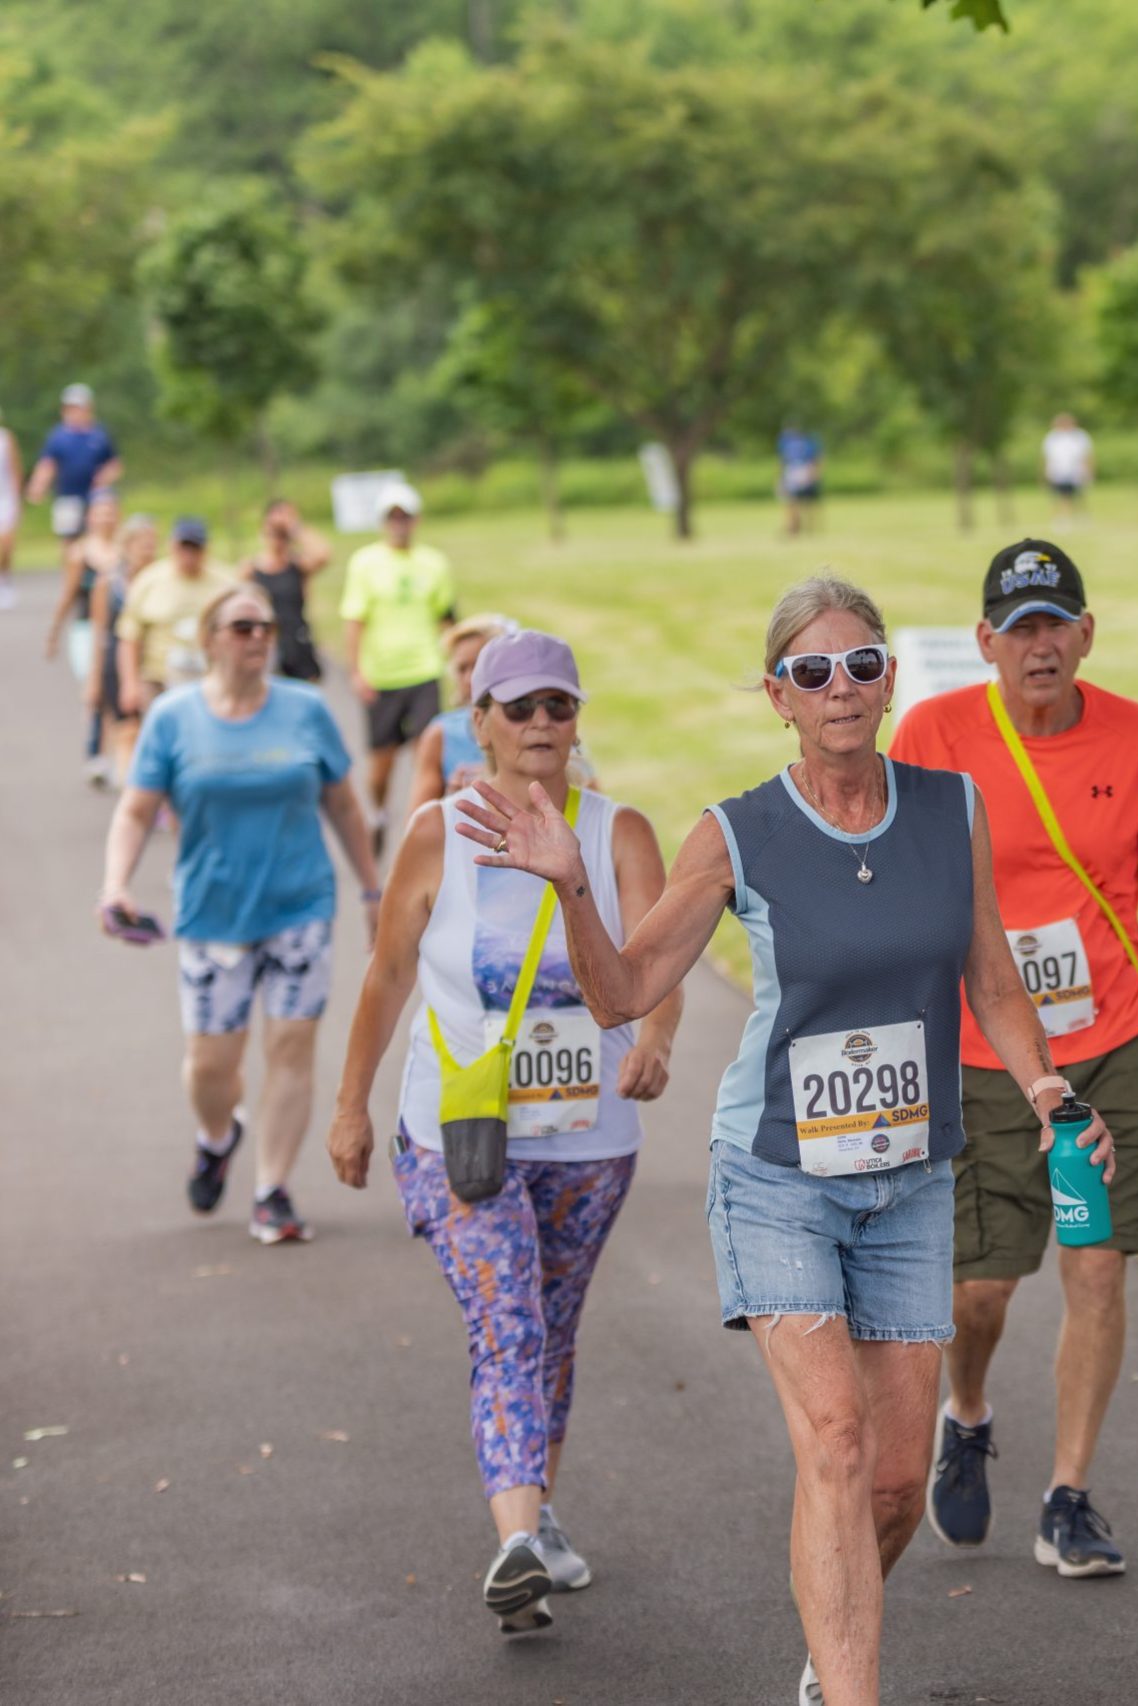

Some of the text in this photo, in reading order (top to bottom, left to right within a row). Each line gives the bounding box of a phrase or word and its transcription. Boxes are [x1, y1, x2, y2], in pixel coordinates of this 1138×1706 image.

[1023, 951, 1077, 994] 097
[509, 1047, 592, 1088] 0096
[803, 1060, 920, 1120] 20298
[799, 1125, 818, 1134] Walk
[820, 1121, 856, 1133] Presented
[892, 1105, 928, 1121] SDMG
[1053, 1204, 1089, 1222] DMG
